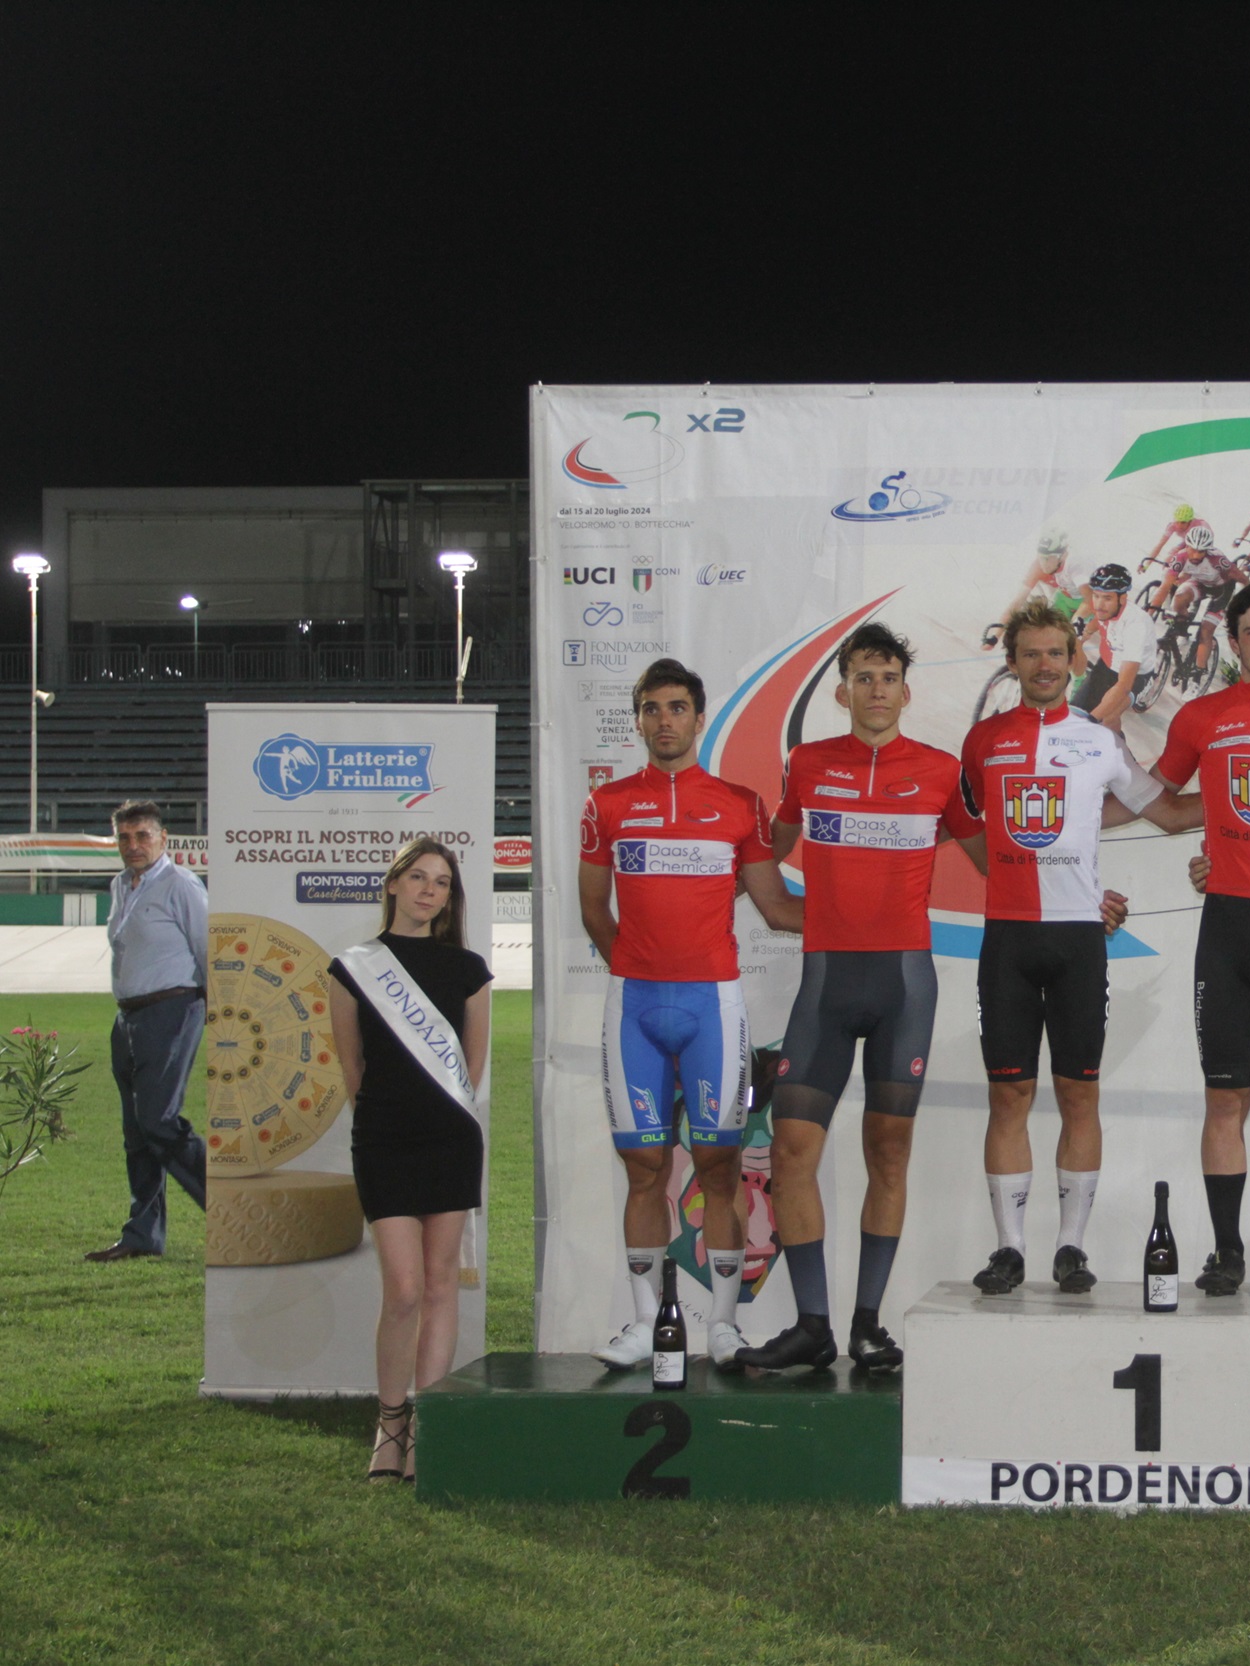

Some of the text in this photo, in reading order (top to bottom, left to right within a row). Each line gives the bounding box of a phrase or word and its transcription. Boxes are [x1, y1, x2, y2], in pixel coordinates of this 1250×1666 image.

[559, 507, 572, 515] dal
[585, 507, 593, 515] al
[606, 507, 629, 516] luglio
[630, 507, 651, 515] 2024
[559, 521, 616, 529] VELODROMO
[572, 567, 616, 585] UCI
[655, 568, 680, 576] CONI
[719, 570, 746, 580] UEC
[591, 641, 671, 653] FONDAZIONE
[591, 654, 627, 666] FRIULI
[601, 735, 630, 743] GIULIA
[327, 748, 418, 766] Latterie
[327, 769, 423, 787] Friulane
[328, 808, 339, 816] dal
[844, 817, 901, 835] Daas &
[225, 830, 393, 844] SCOPRI IL NOSTRO
[844, 833, 926, 848] Chemicals
[235, 849, 326, 863] ASSAGGIA
[495, 849, 532, 858] ONCADI
[649, 844, 702, 862] Daas &
[1018, 853, 1026, 865] di
[1028, 854, 1081, 866] Pordenone
[649, 861, 725, 874] Chemicals
[301, 876, 367, 887] MONTASIO
[355, 890, 373, 901] 018
[376, 969, 471, 1094] FONDAZIONE
[1113, 1354, 1161, 1451] 1
[623, 1401, 692, 1500] 2
